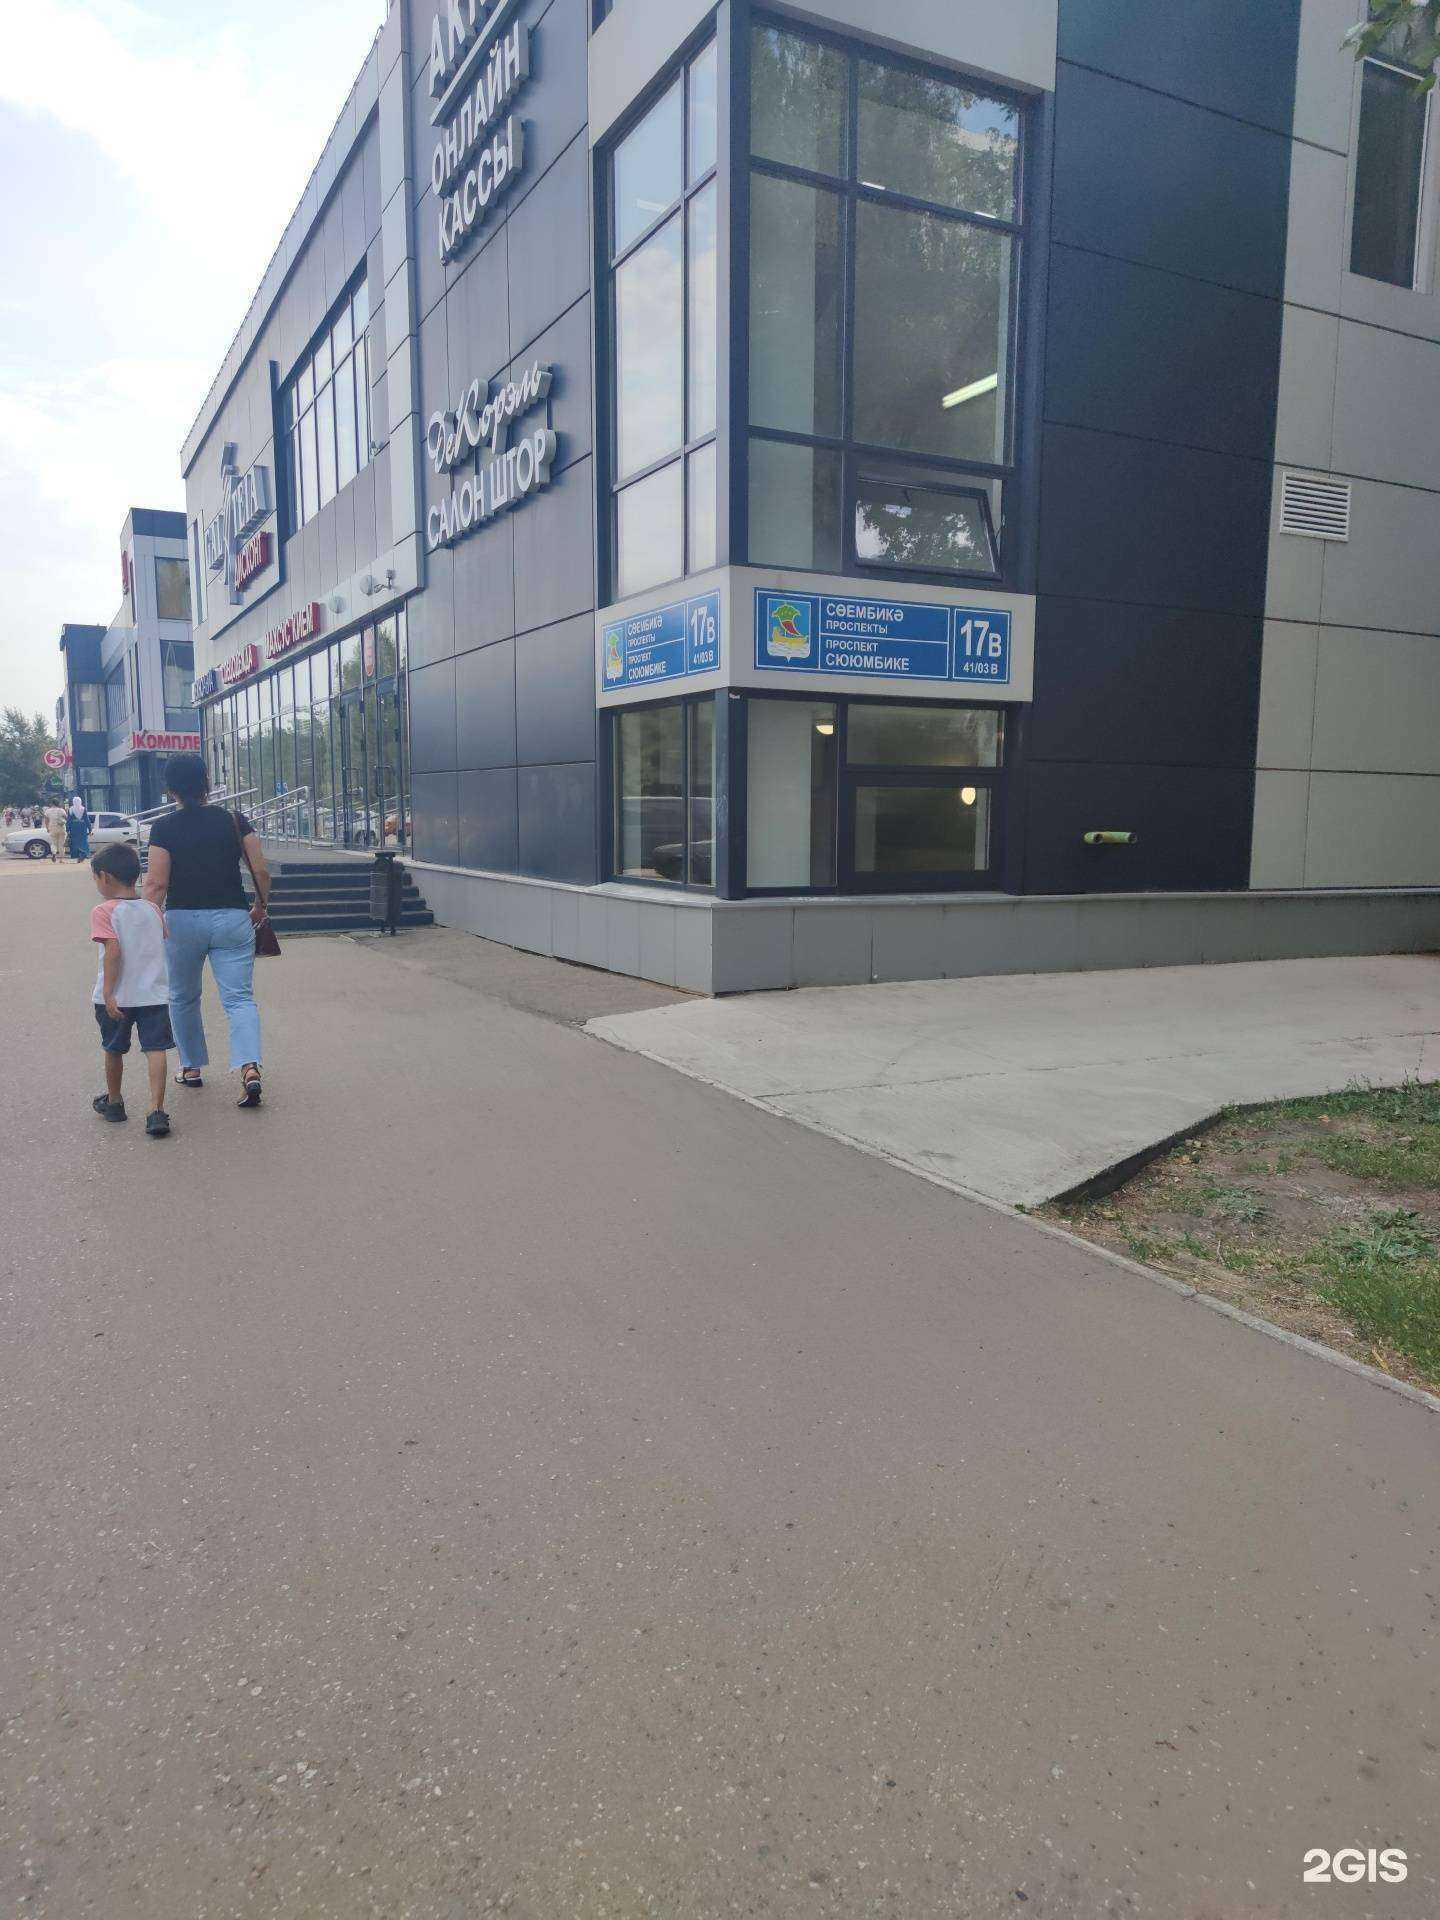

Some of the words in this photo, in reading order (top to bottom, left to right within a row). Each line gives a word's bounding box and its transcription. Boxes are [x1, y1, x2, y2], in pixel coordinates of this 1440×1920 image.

[431, 19, 520, 196] ОНЛАЙН
[439, 115, 513, 259] КАССЫ
[428, 469, 485, 549] САЛОН
[490, 428, 546, 512] ШТОР
[826, 603, 904, 622] СӨЕМБИКӘ
[826, 620, 888, 635] ПРОСПЕКТЫ
[826, 639, 879, 652] ПРОСПЕКТ
[960, 619, 1002, 657] 17В
[628, 651, 652, 665] ПРОСПЕКТ
[826, 653, 910, 671] СЮЮМБИКЕ
